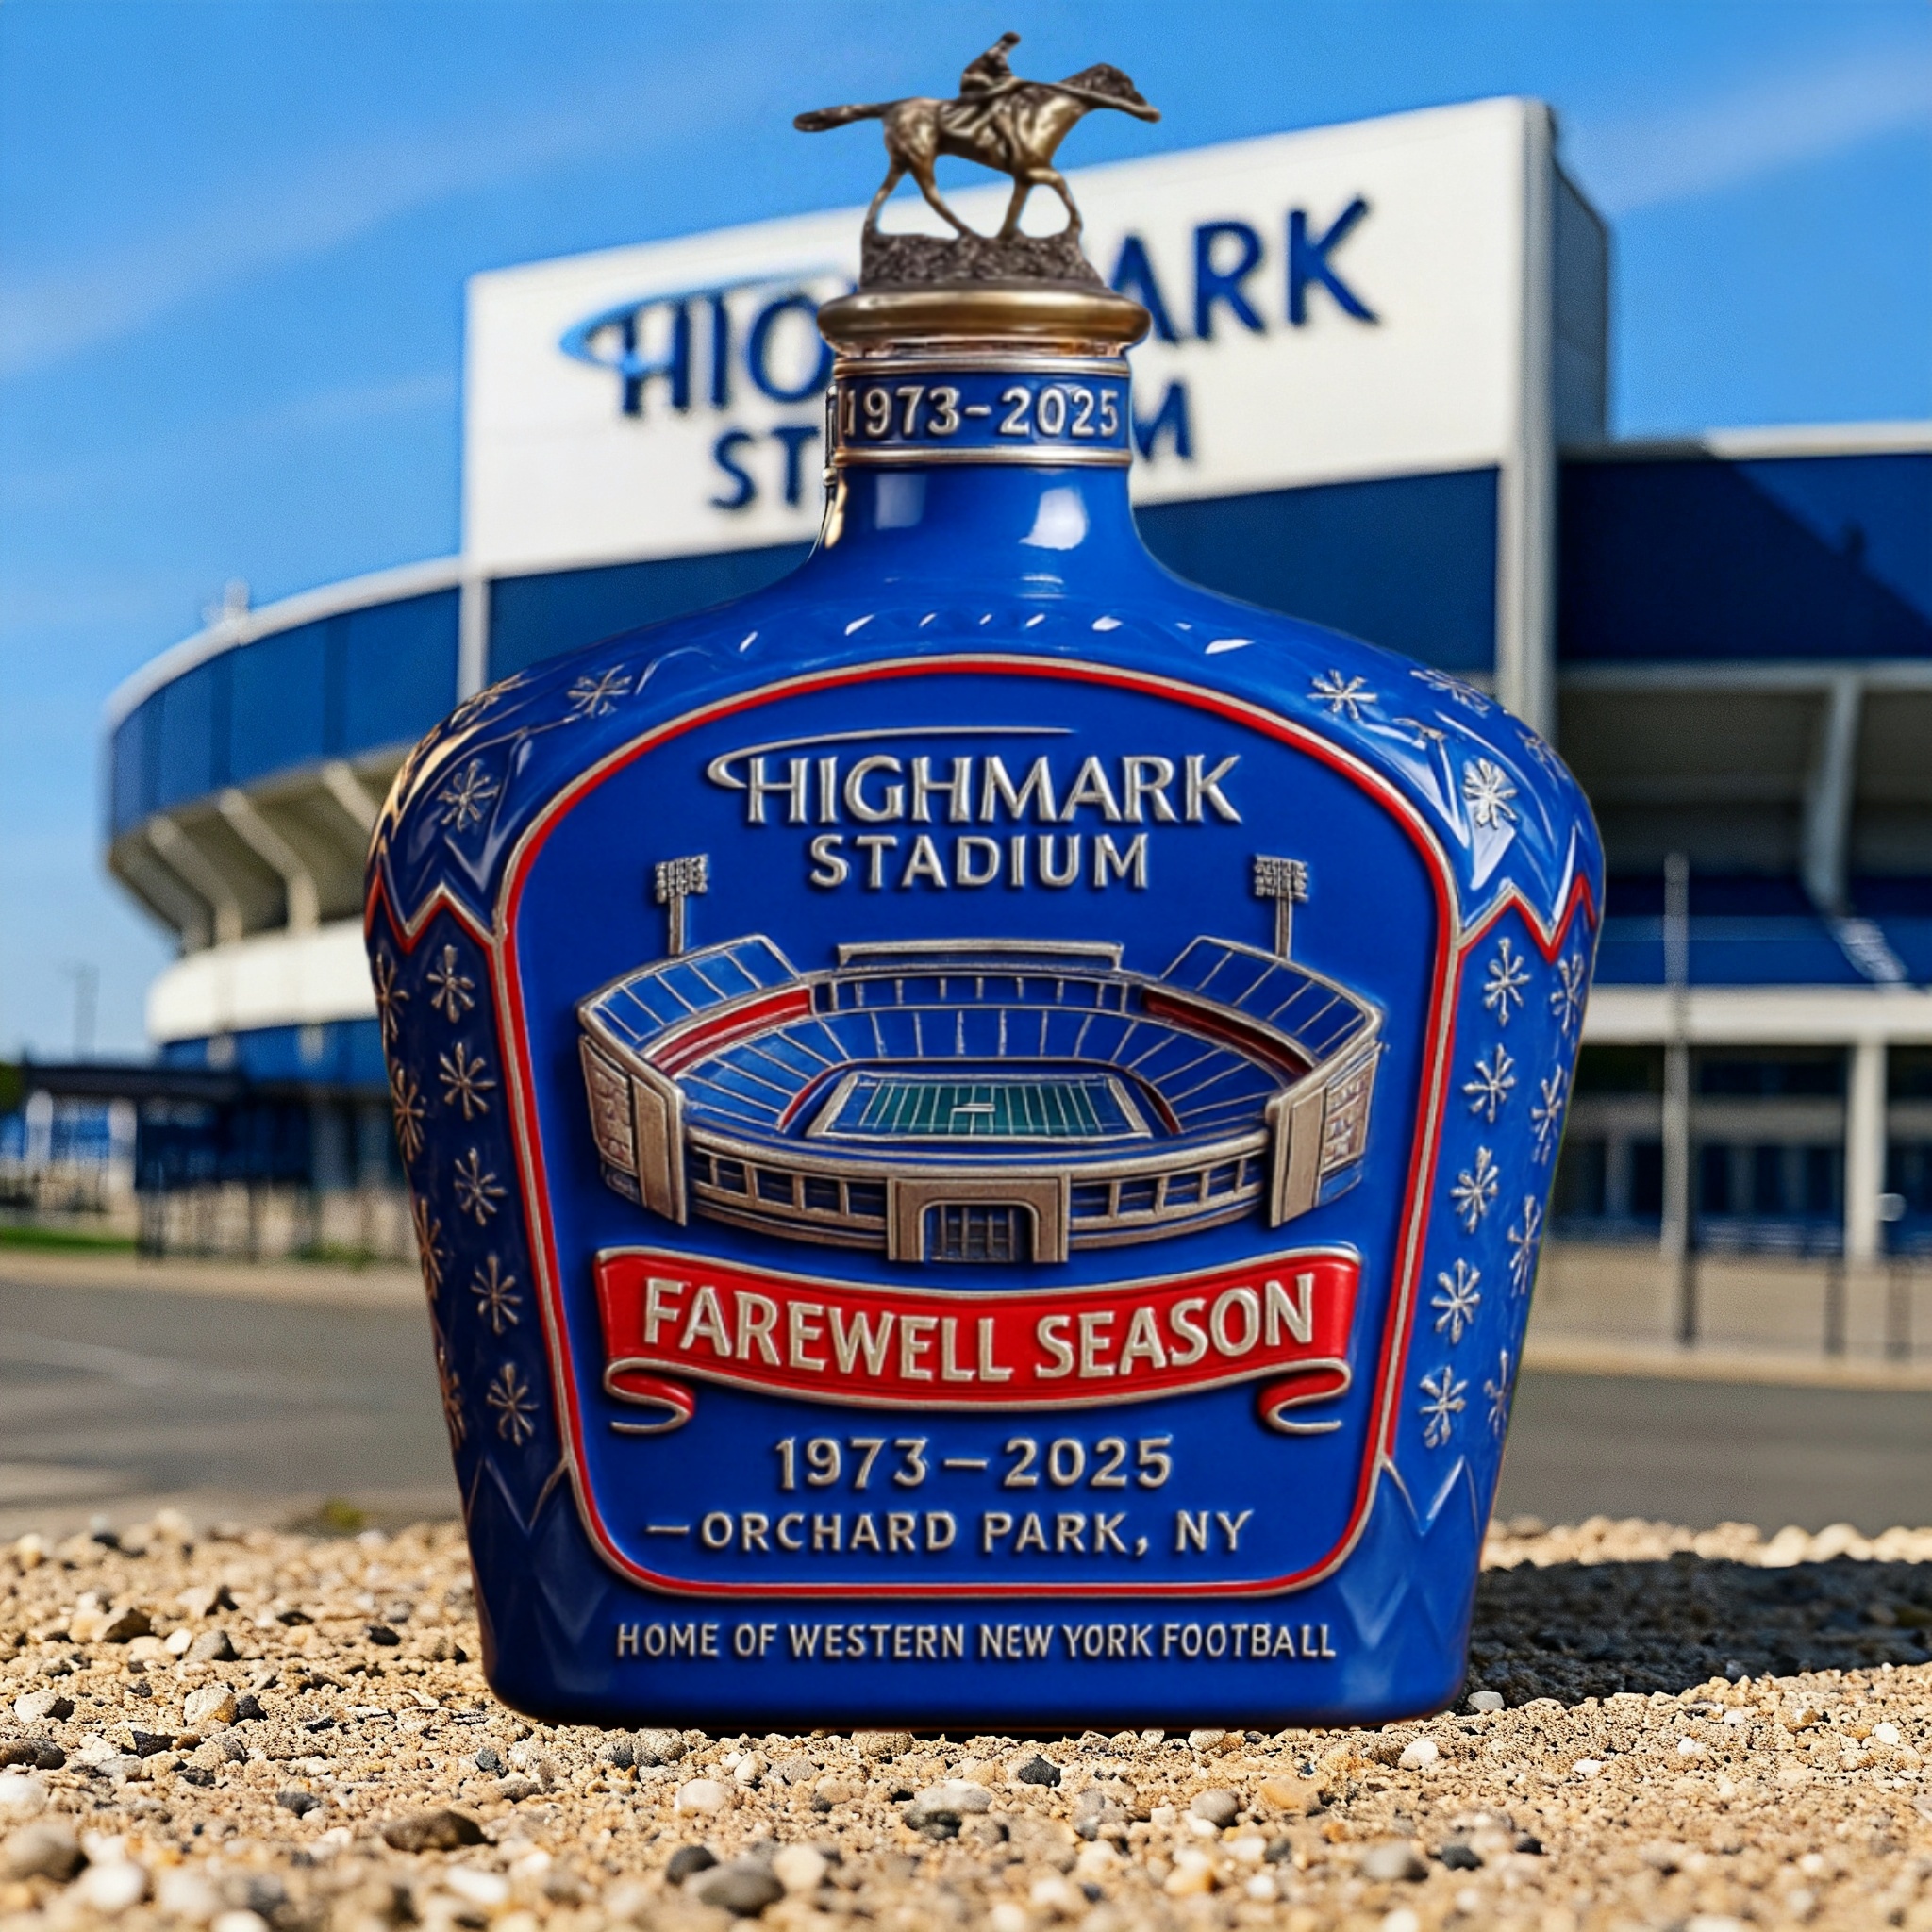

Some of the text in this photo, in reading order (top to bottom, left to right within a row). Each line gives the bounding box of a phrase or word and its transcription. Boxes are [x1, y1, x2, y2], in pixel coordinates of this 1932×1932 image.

[746, 753, 1243, 824] HIGHMARK
[809, 833, 1149, 889] STADIUM
[644, 1272, 1315, 1382] FAREWELL SEASON
[983, 1511, 1149, 1557] PARK,
[1175, 1509, 1254, 1552] NY
[616, 1622, 1337, 1658] HOME OF WESTERN NEW YORK FOOTBALL
